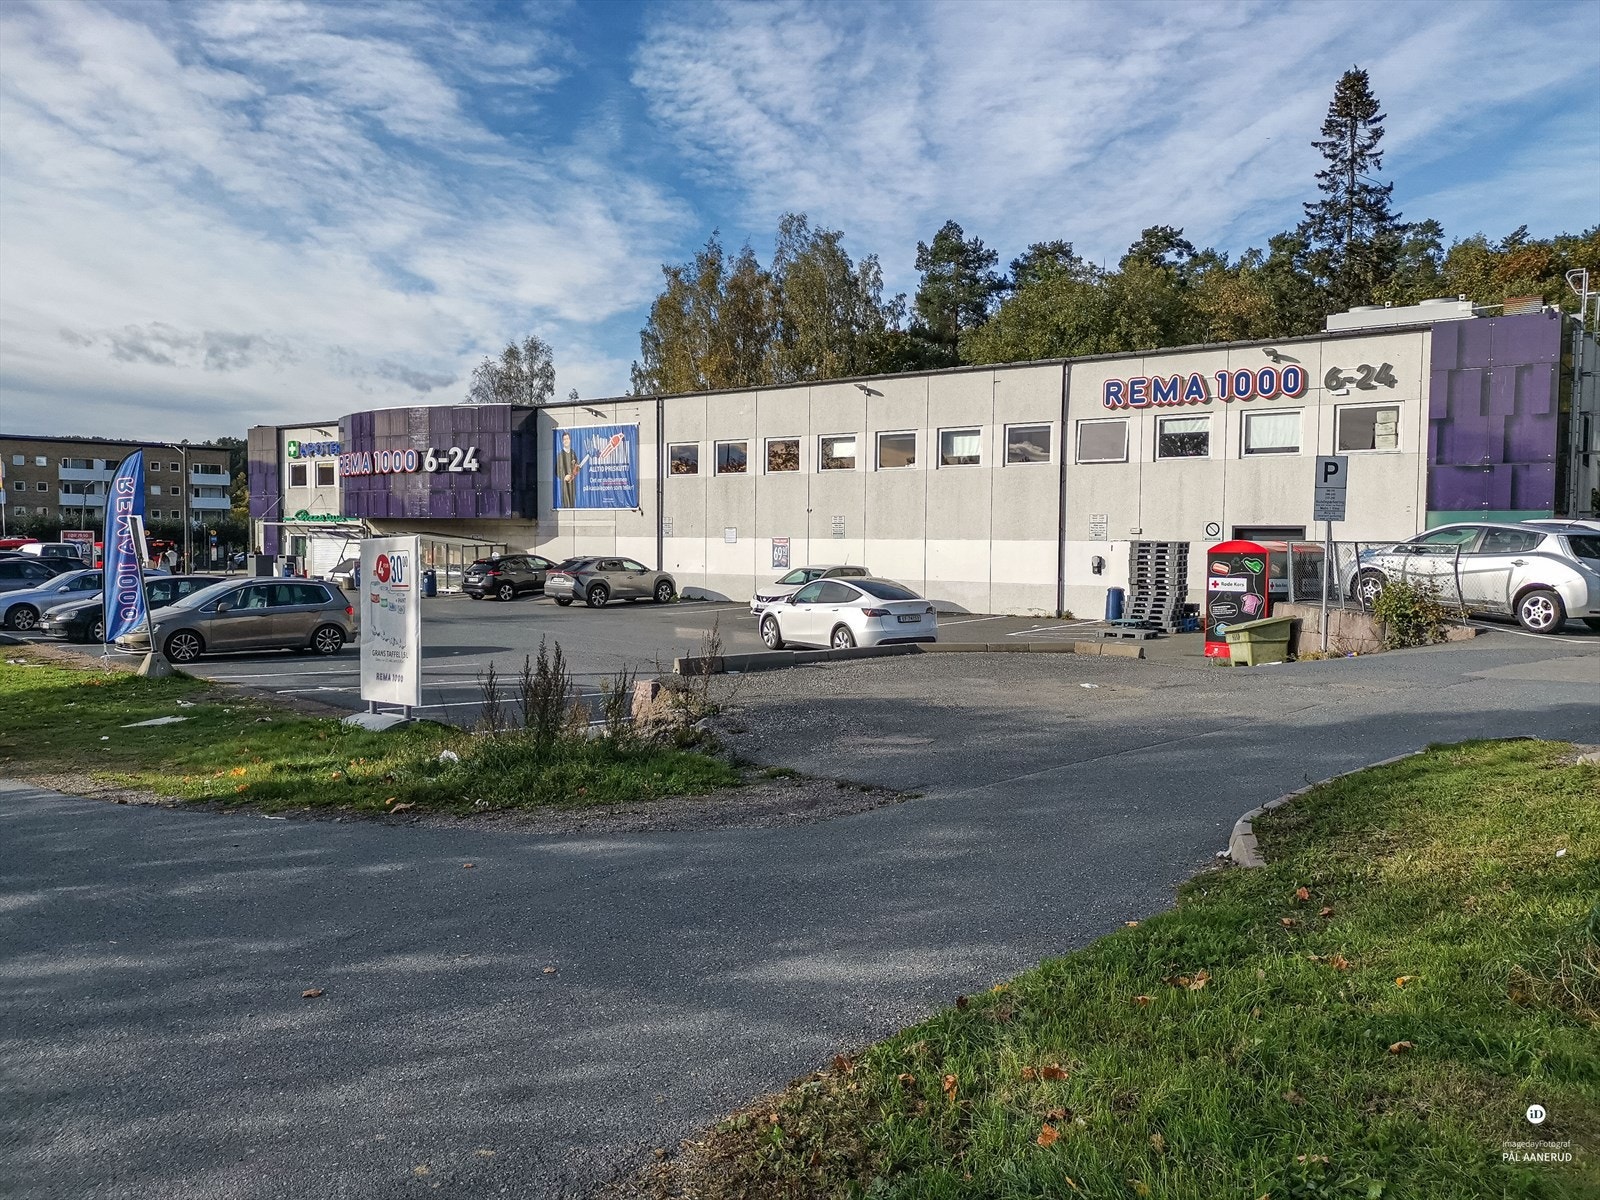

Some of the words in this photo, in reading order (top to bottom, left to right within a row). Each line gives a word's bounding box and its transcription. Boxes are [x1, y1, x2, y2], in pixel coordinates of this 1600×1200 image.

[1103, 372, 1208, 409] REMA
[1215, 364, 1305, 401] 1000
[1324, 362, 1398, 391] 6-24
[339, 451, 372, 476] REMA
[374, 448, 419, 474] 1000
[424, 446, 479, 472] 6-24
[1323, 461, 1339, 483] P
[378, 560, 385, 577] 4
[390, 555, 403, 583] 30
[376, 672, 391, 681] REMA
